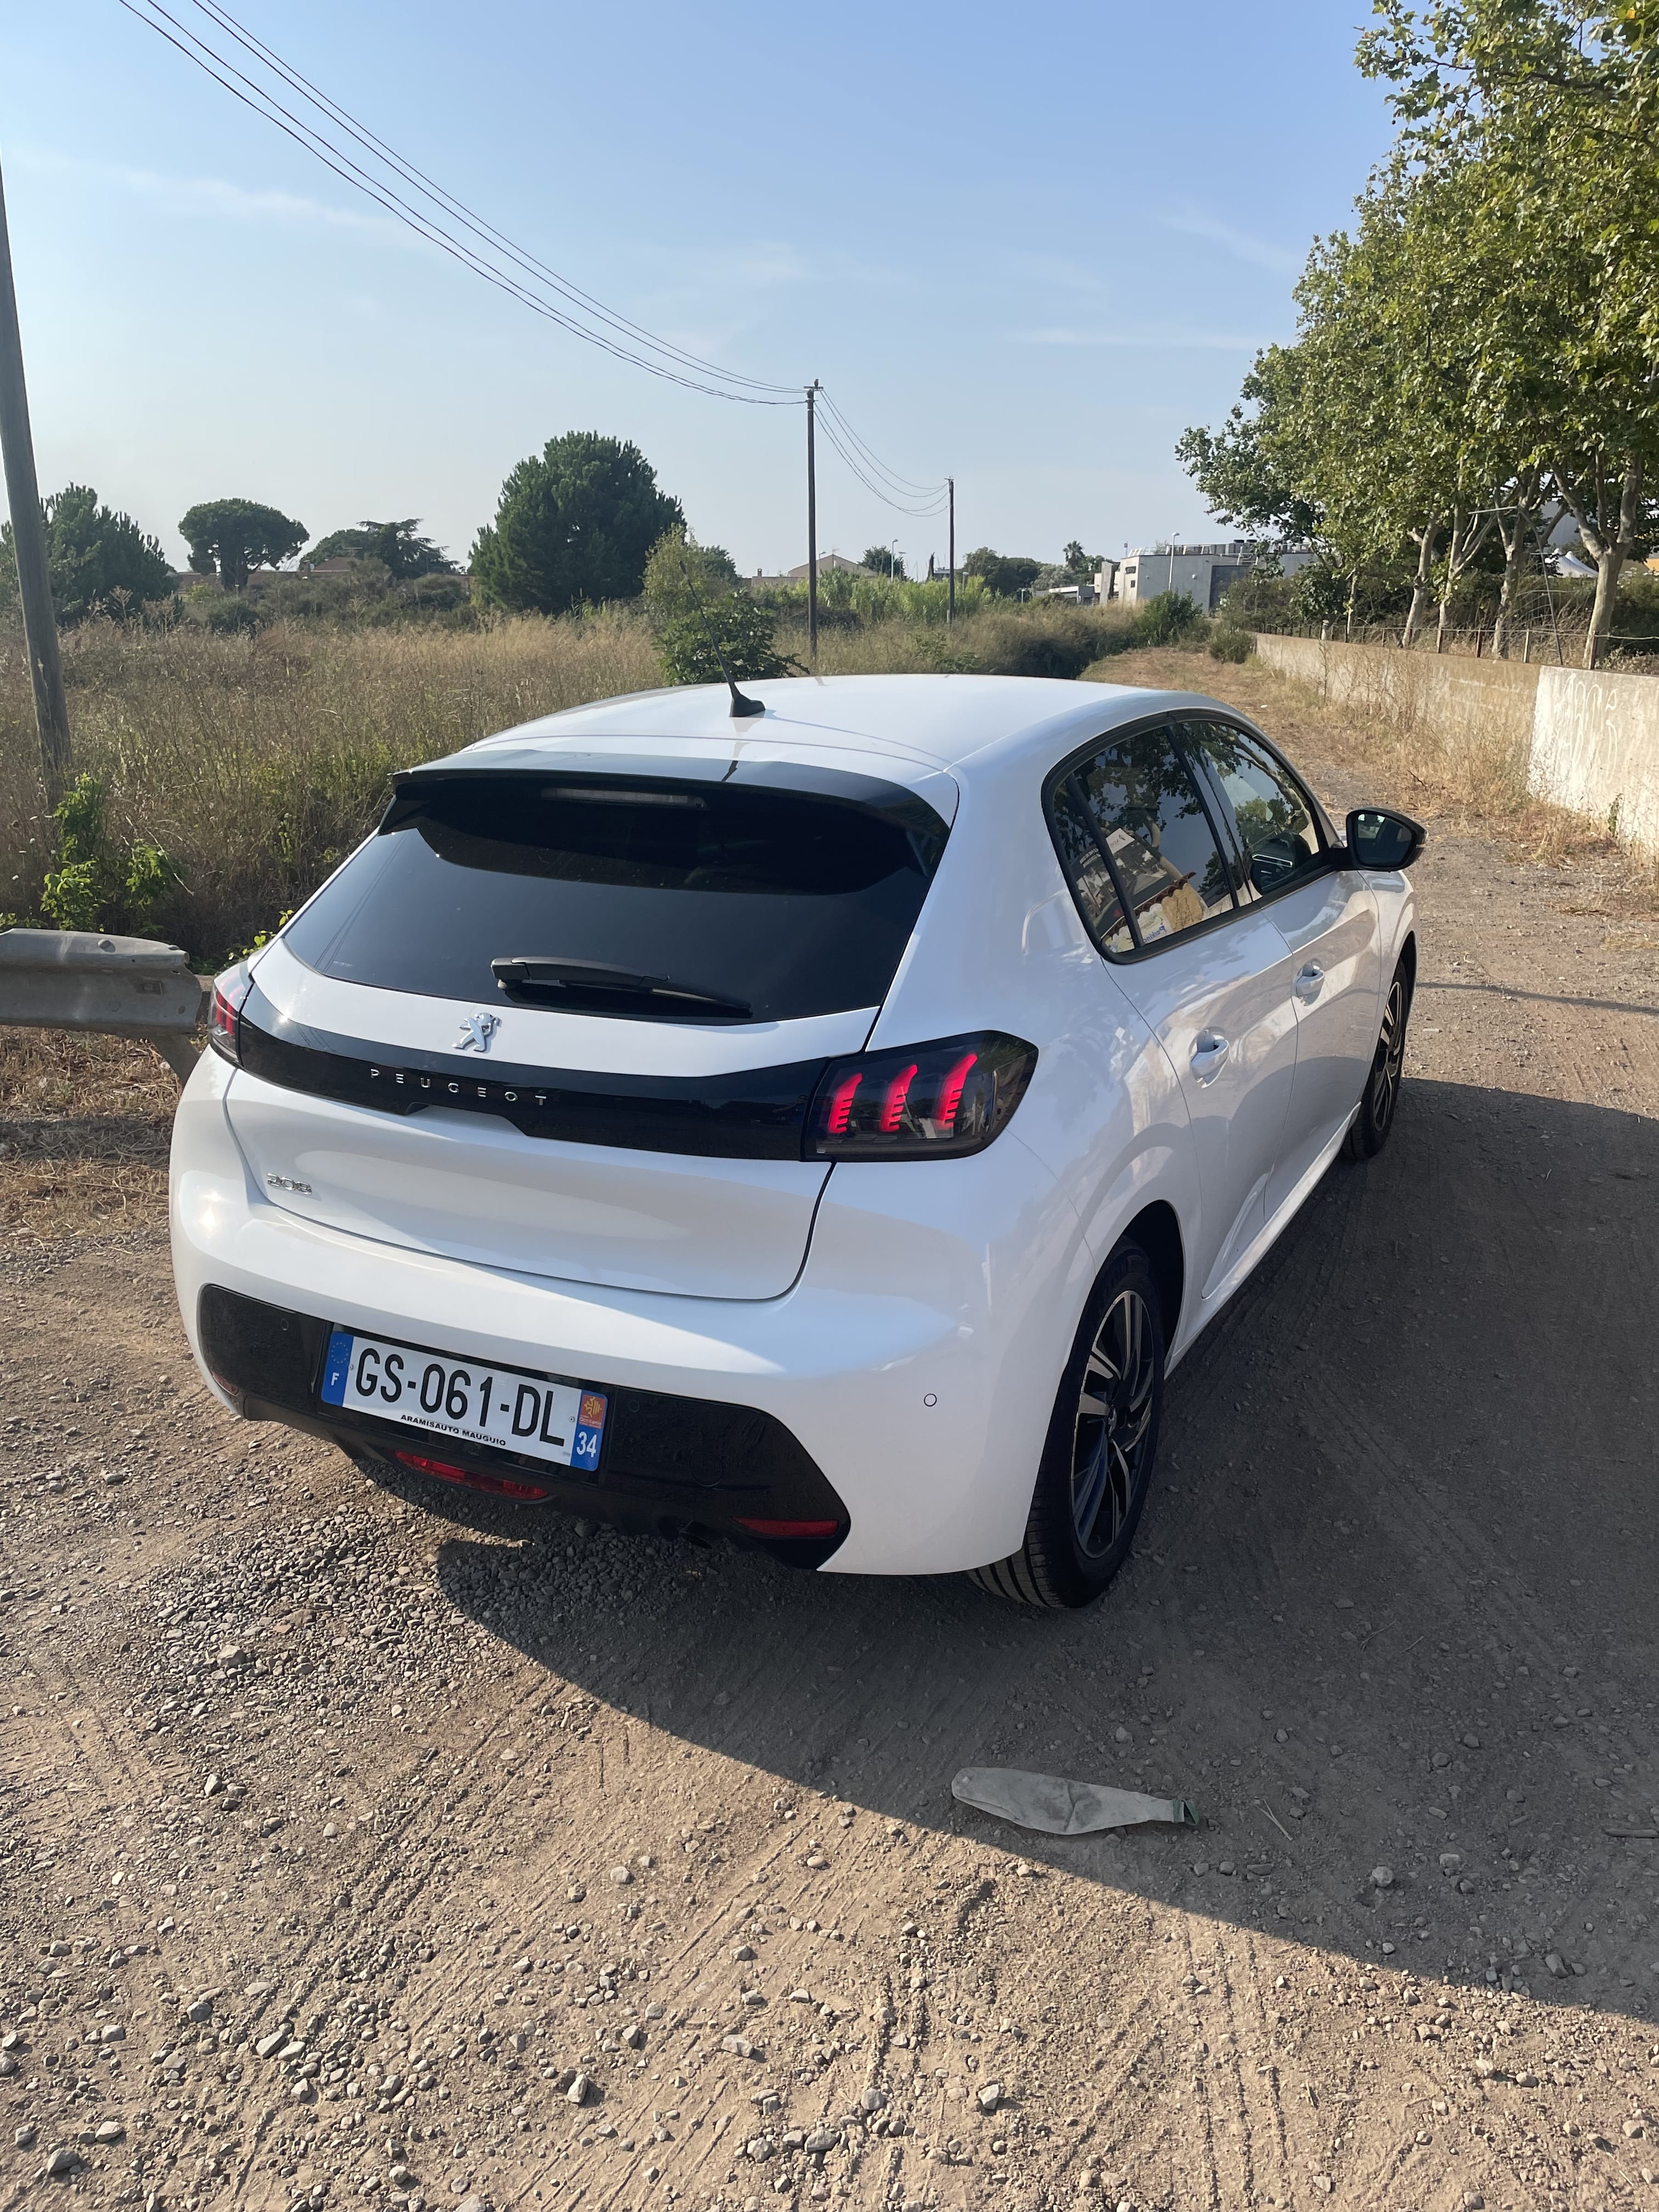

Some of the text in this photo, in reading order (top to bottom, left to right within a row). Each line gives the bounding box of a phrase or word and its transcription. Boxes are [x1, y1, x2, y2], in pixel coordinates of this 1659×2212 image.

[370, 1069, 546, 1106] PEUGEOT
[267, 1173, 312, 1195] 208
[331, 1372, 340, 1386] F
[356, 1348, 565, 1447] GS-061-DL
[400, 1414, 506, 1446] ARAMISAUTO MAUGUIO
[576, 1431, 597, 1458] 34
